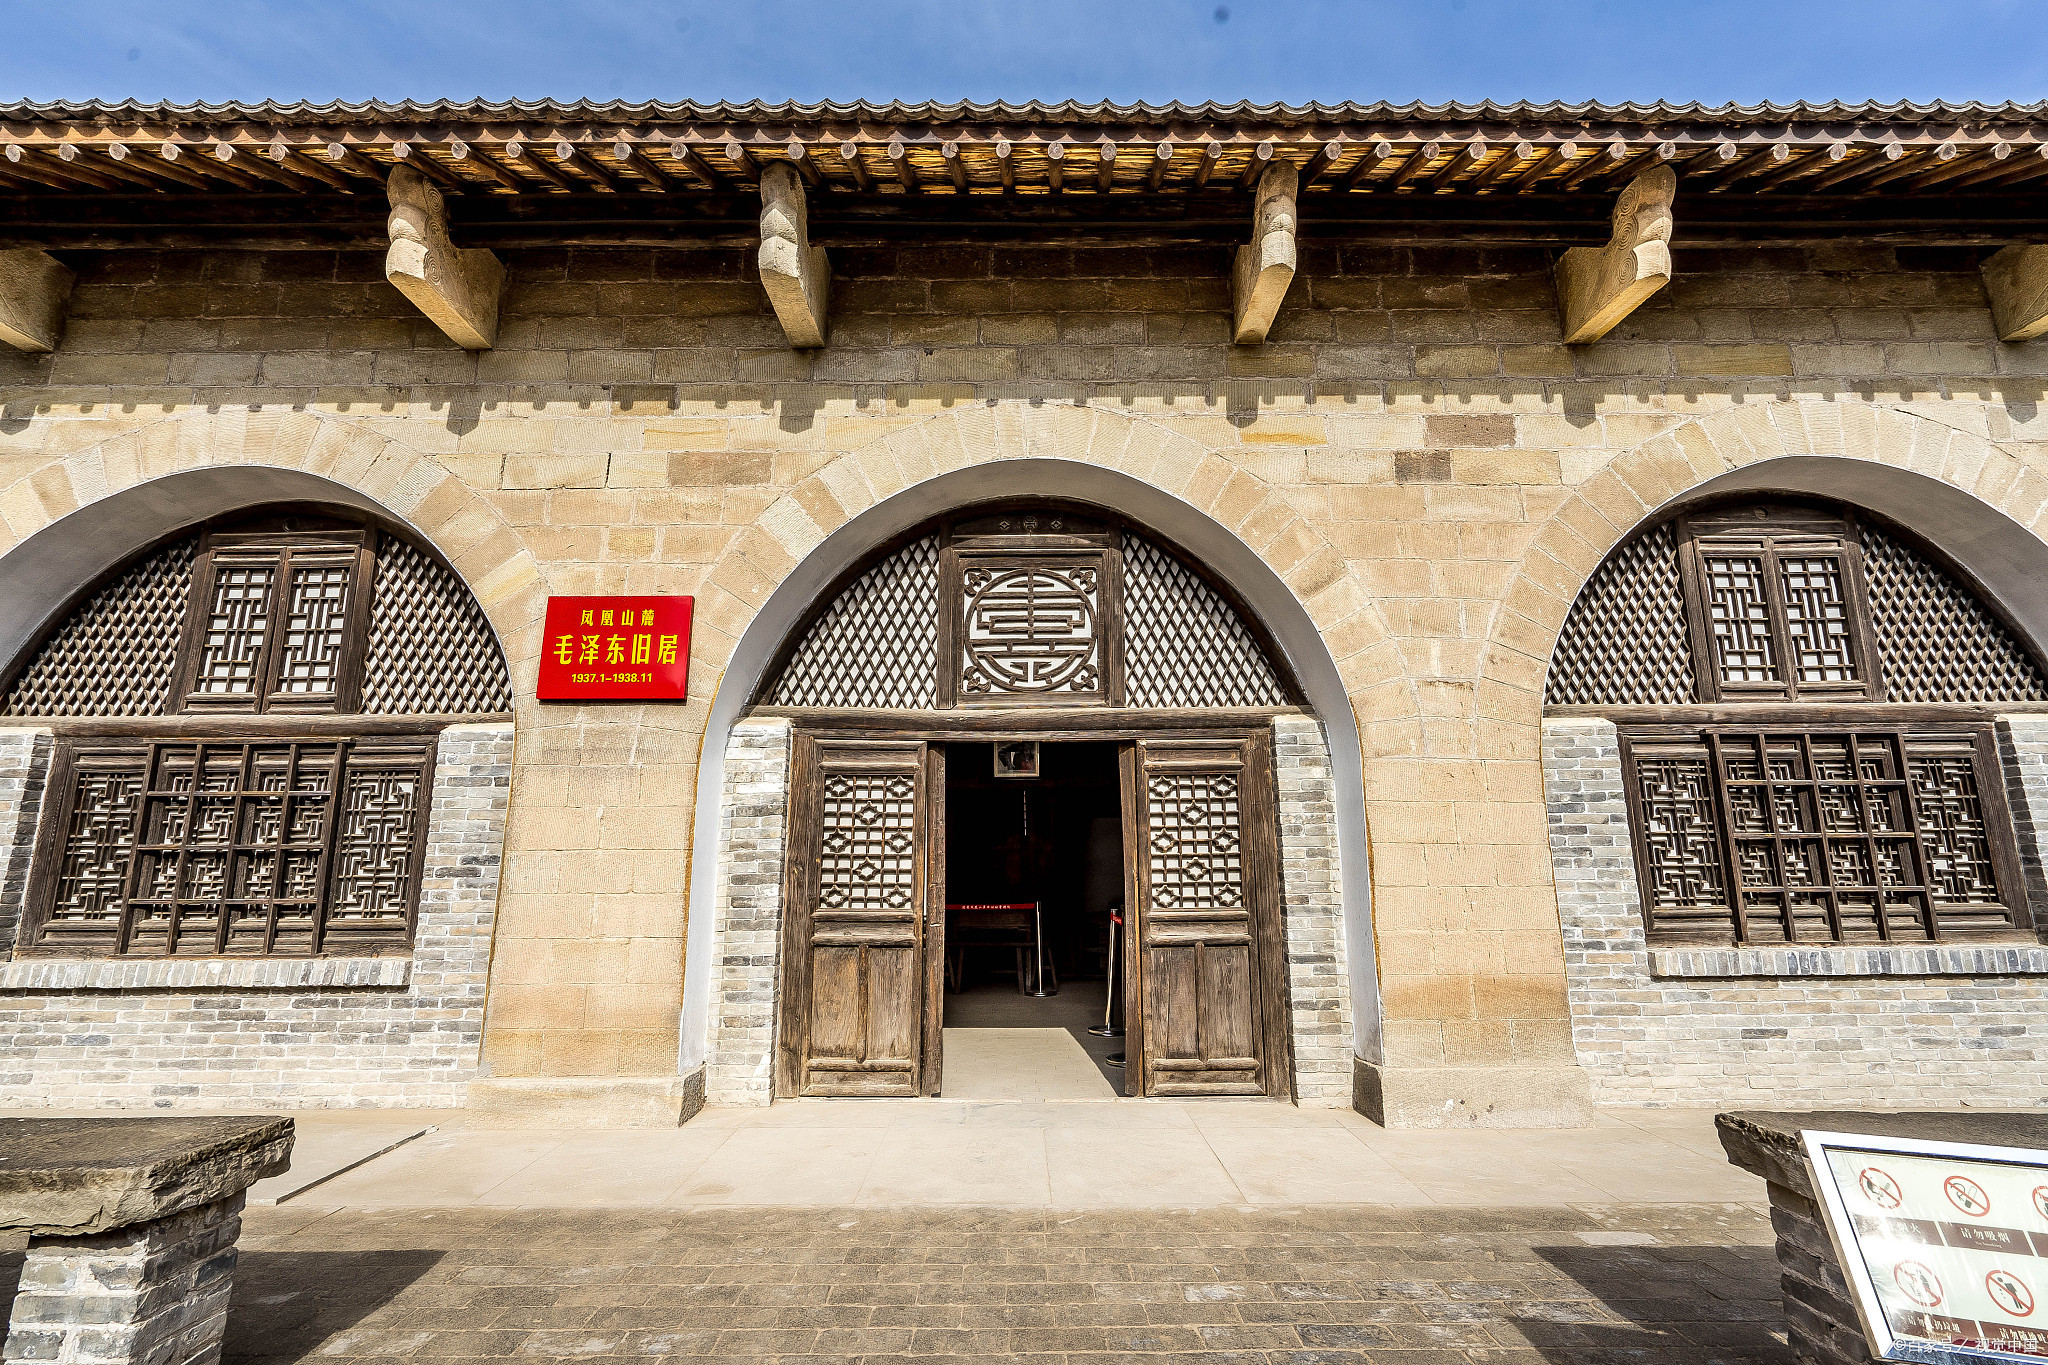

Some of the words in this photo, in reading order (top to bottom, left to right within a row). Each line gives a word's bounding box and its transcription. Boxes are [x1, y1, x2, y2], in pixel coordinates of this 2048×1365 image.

[580, 609, 655, 627] 凤凰山麓
[553, 634, 679, 666] 毛泽东旧居
[571, 672, 653, 683] 1937.1-1938.11
[1960, 1227, 2011, 1243] 请勿吸烟
[1907, 1315, 1962, 1334] 请勿扔垃圾
[1998, 1327, 2048, 1344] 请勿随地吐
